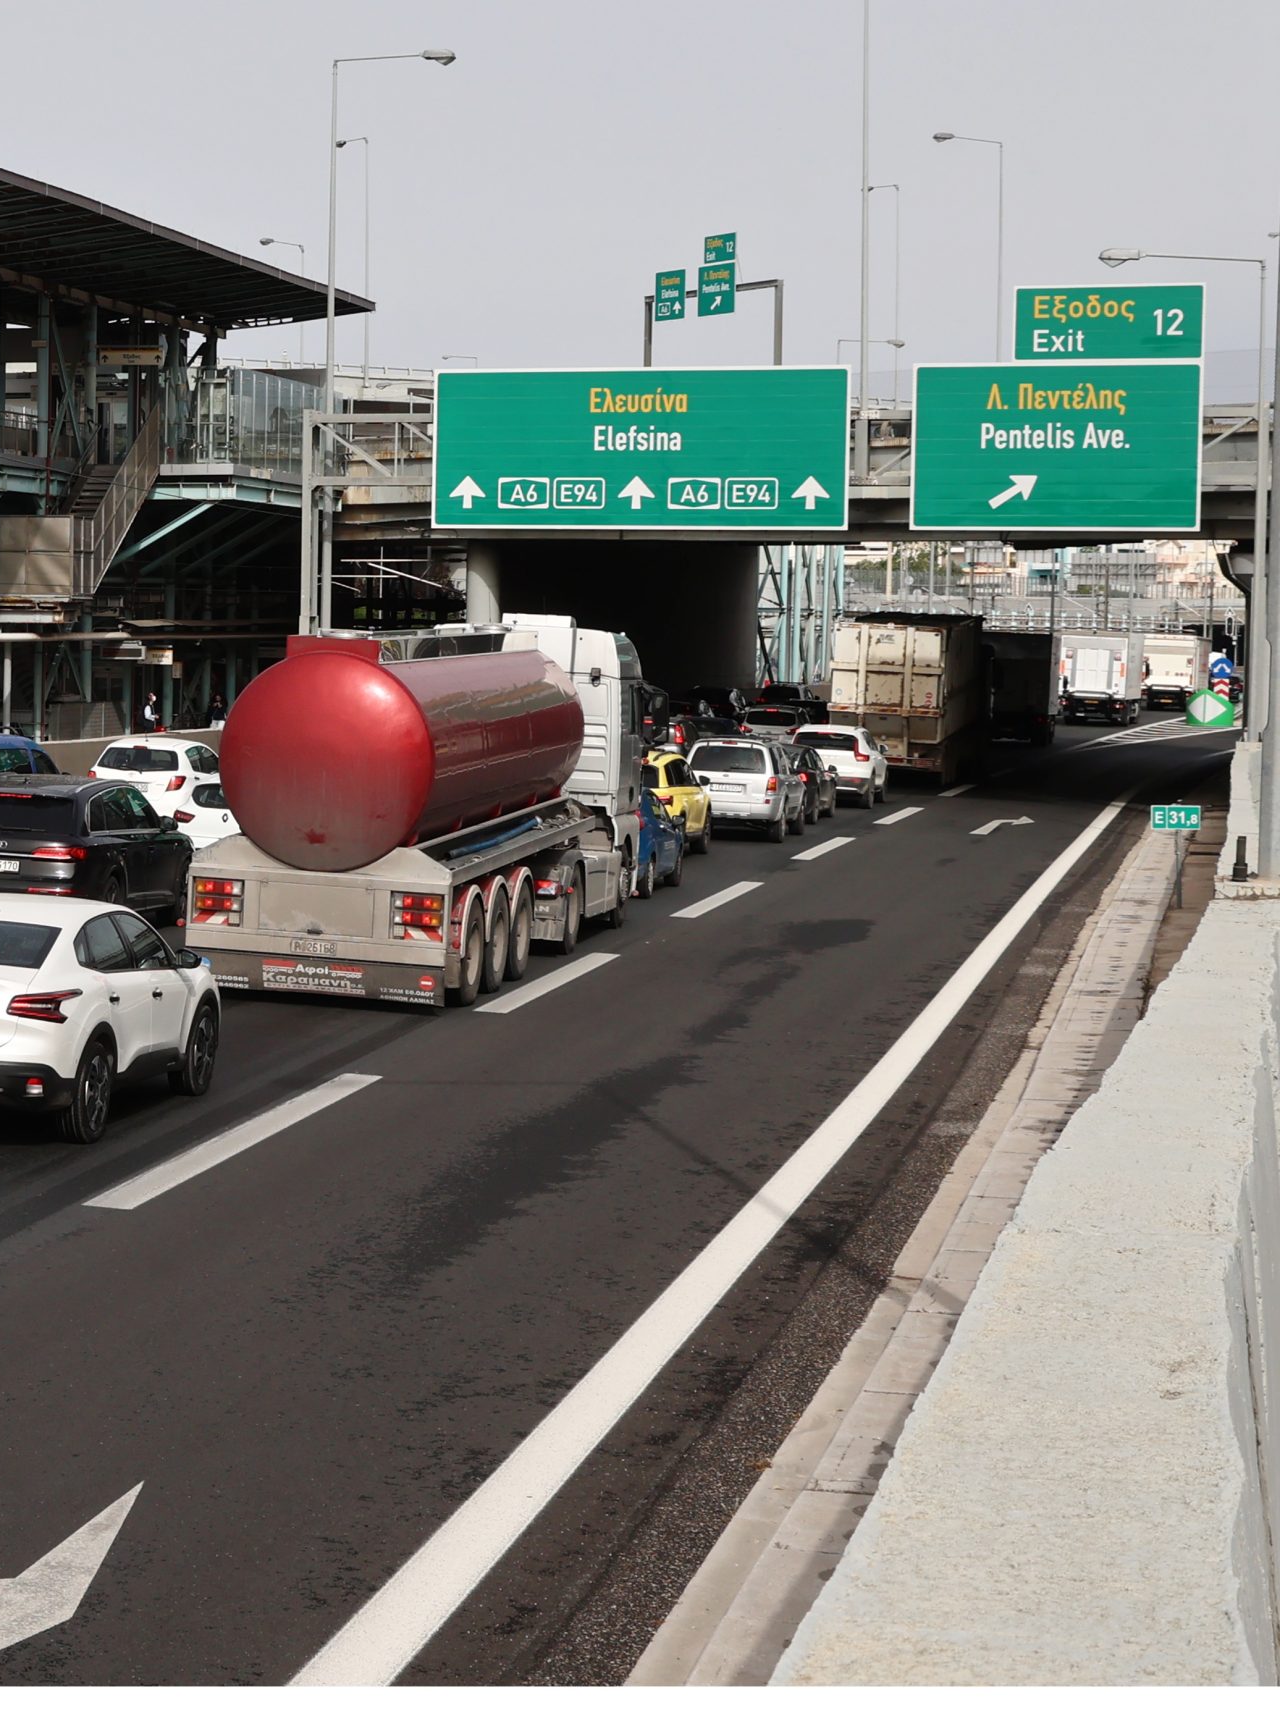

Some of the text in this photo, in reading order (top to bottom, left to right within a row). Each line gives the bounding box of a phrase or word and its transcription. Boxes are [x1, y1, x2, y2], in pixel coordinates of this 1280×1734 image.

[726, 241, 734, 253] 12
[1033, 294, 1136, 323] Εξοδος
[1153, 308, 1184, 336] 12
[1033, 328, 1085, 352] Exit
[589, 387, 688, 413] Ελευσίνα
[986, 383, 1127, 416] Λ. Πεντέλης
[593, 425, 682, 452] Elefsina
[980, 422, 1131, 450] Pentelis Ave.
[510, 484, 598, 503] A6 E94
[680, 484, 771, 503] A6 E94
[1154, 811, 1198, 827] E 31,8
